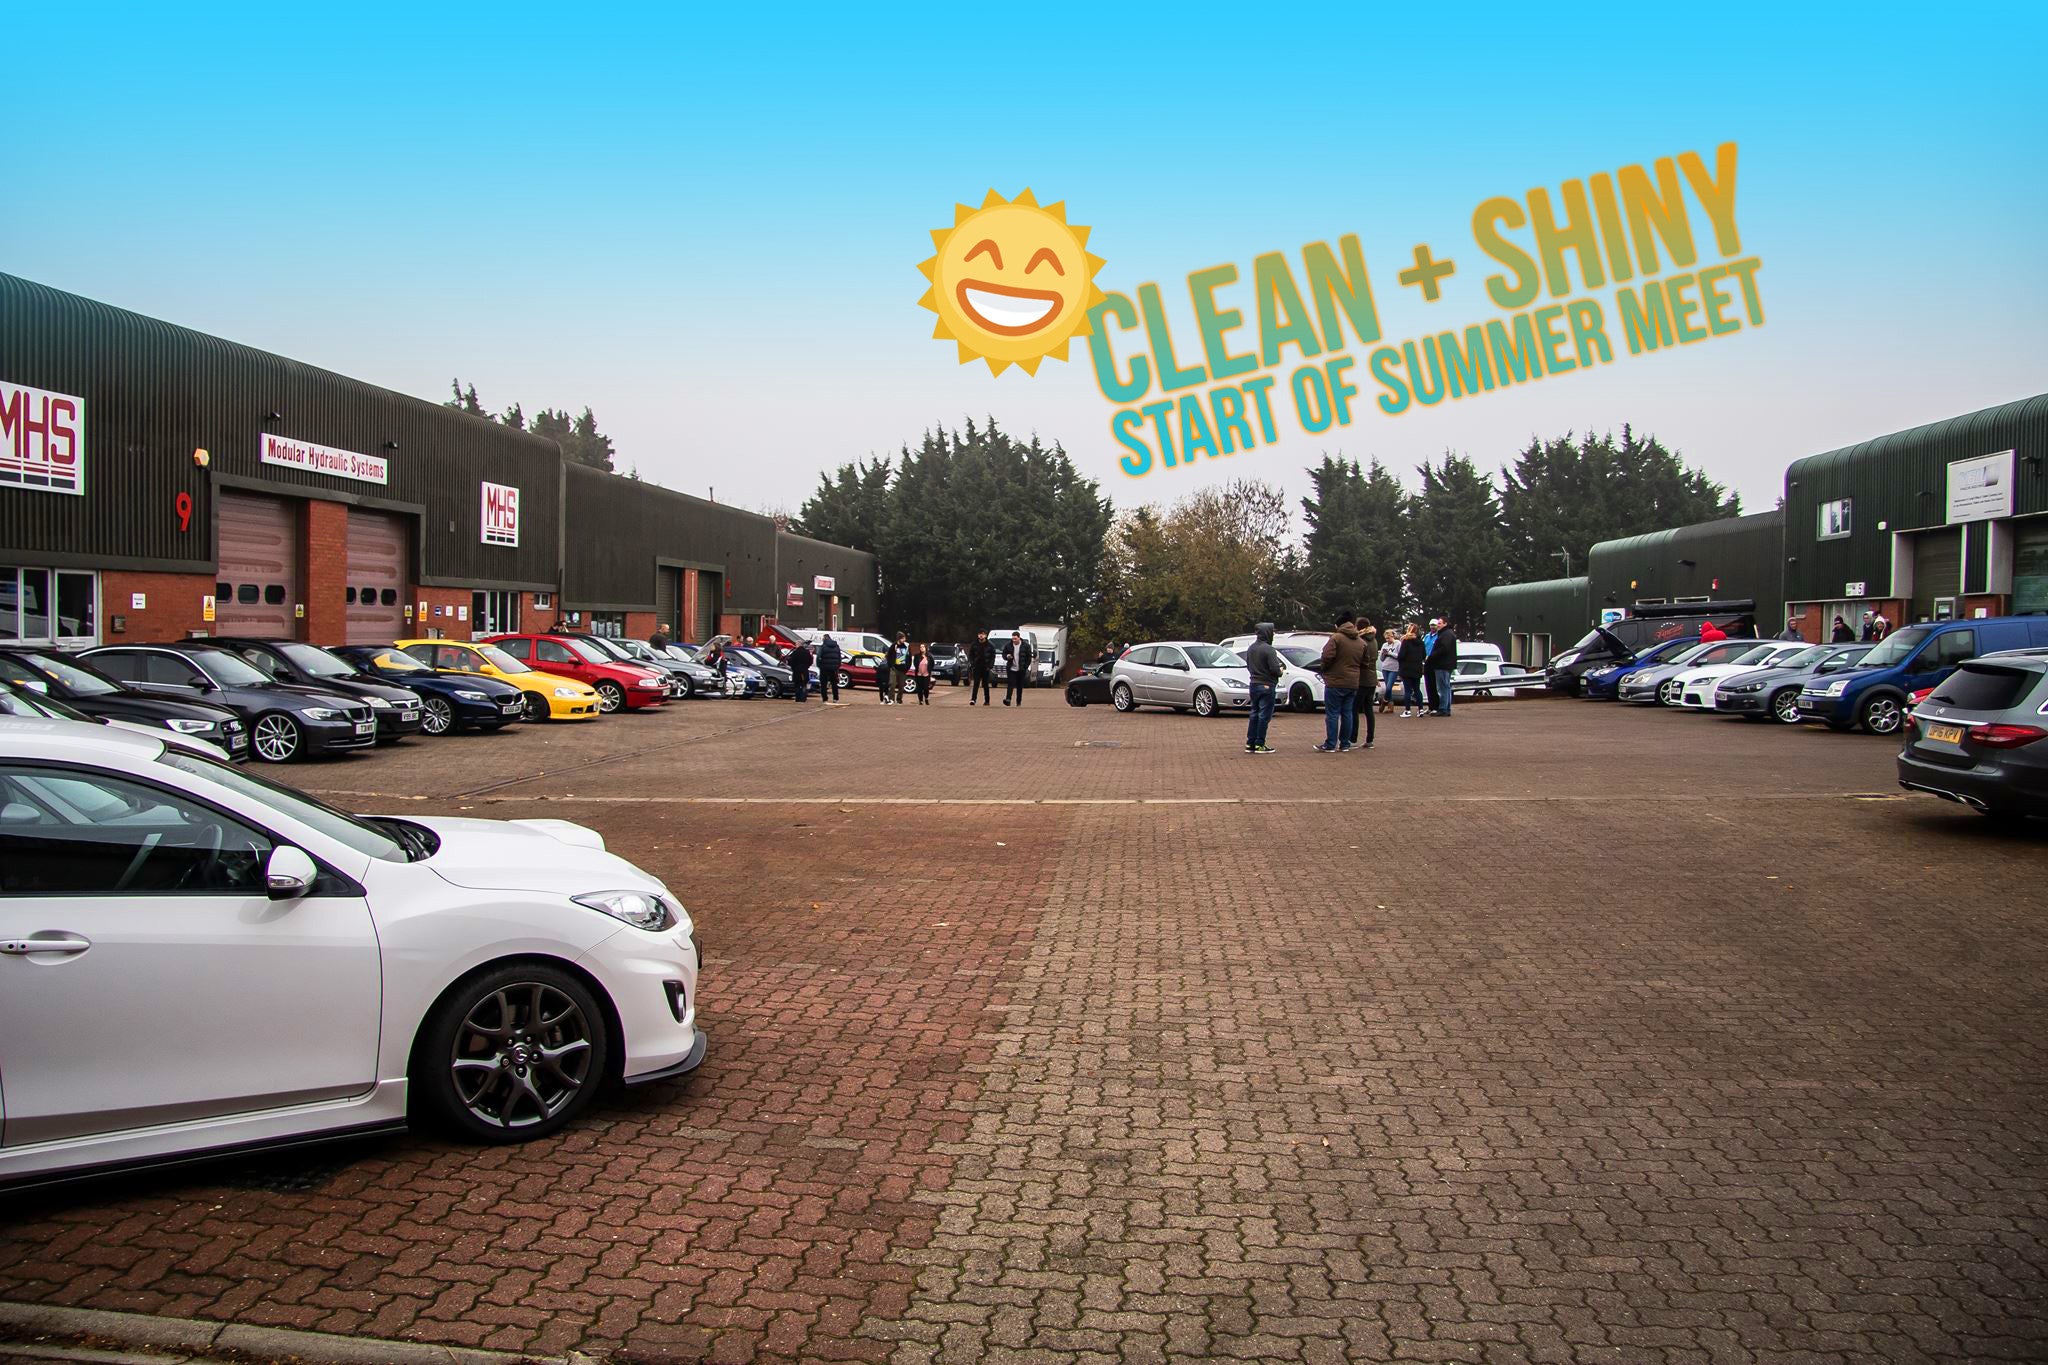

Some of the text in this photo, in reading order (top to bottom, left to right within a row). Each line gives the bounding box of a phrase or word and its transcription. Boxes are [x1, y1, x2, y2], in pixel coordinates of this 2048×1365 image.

[0, 386, 76, 465] MHS
[268, 438, 384, 479] Modular Hydraulic Systems
[176, 491, 192, 532] 9
[487, 486, 515, 529] MHS
